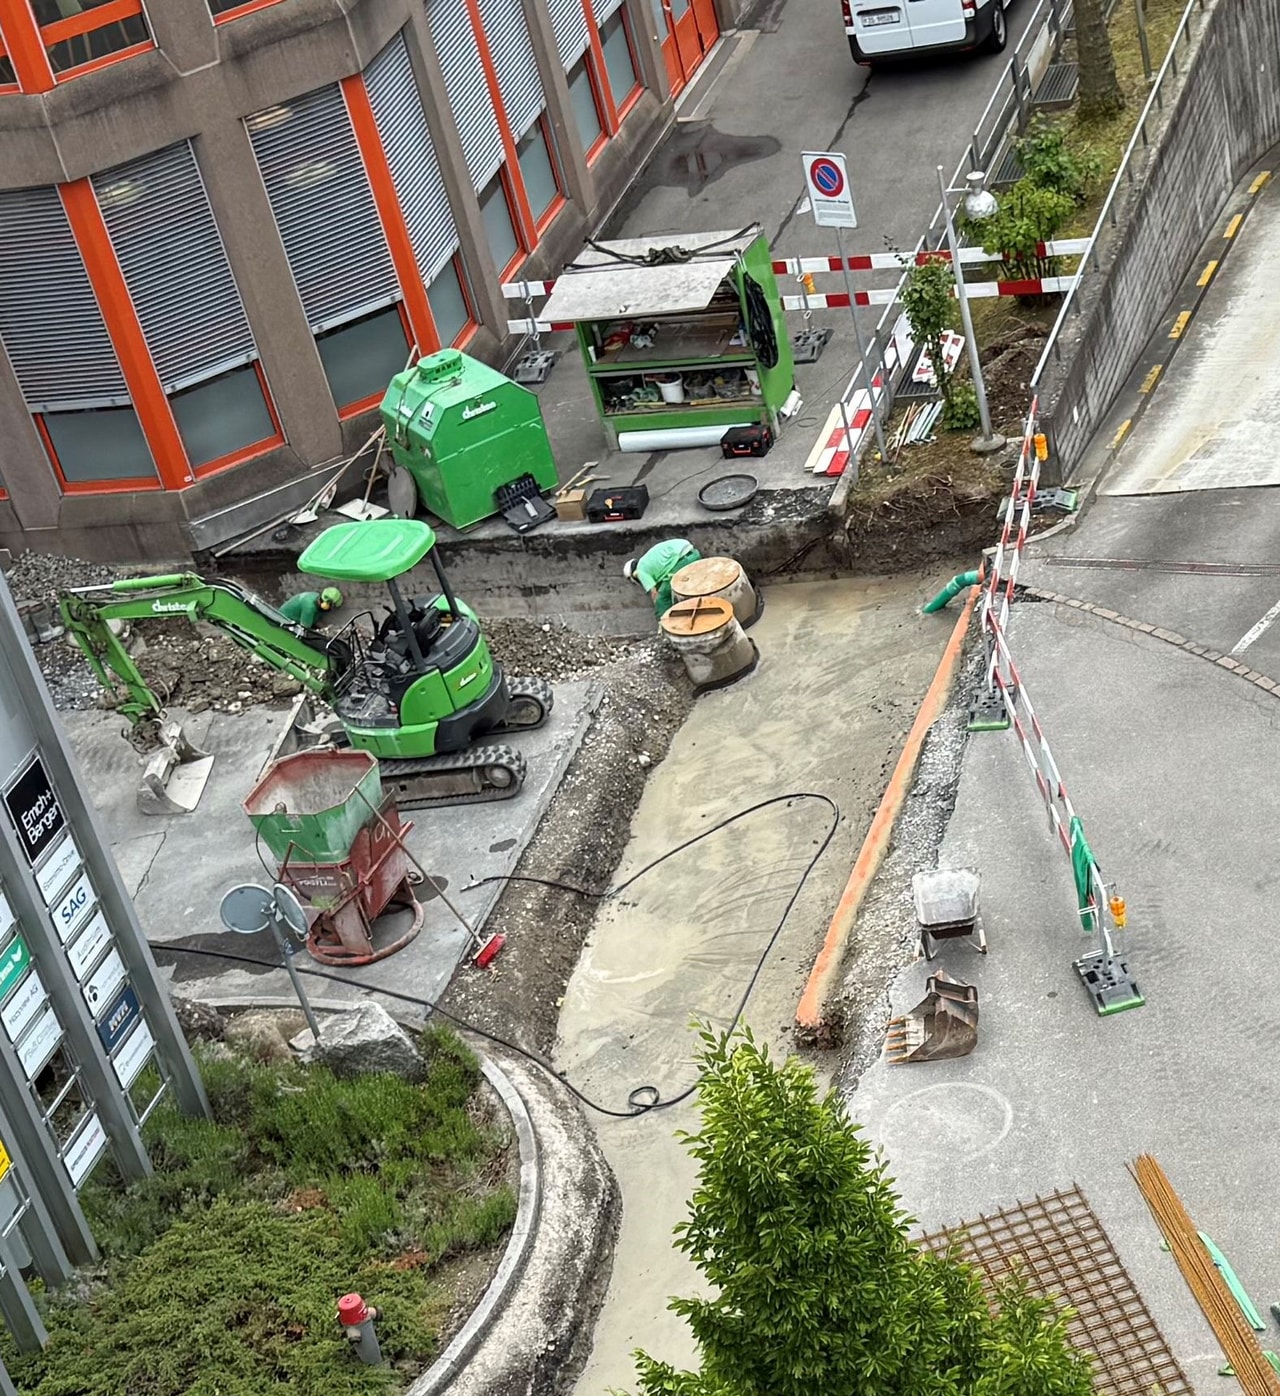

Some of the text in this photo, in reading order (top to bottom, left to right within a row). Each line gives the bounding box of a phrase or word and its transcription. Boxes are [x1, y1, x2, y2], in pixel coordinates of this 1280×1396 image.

[152, 599, 188, 612] christe
[21, 789, 52, 830] Emch+
[61, 887, 87, 924] SAG
[29, 982, 38, 997] AG
